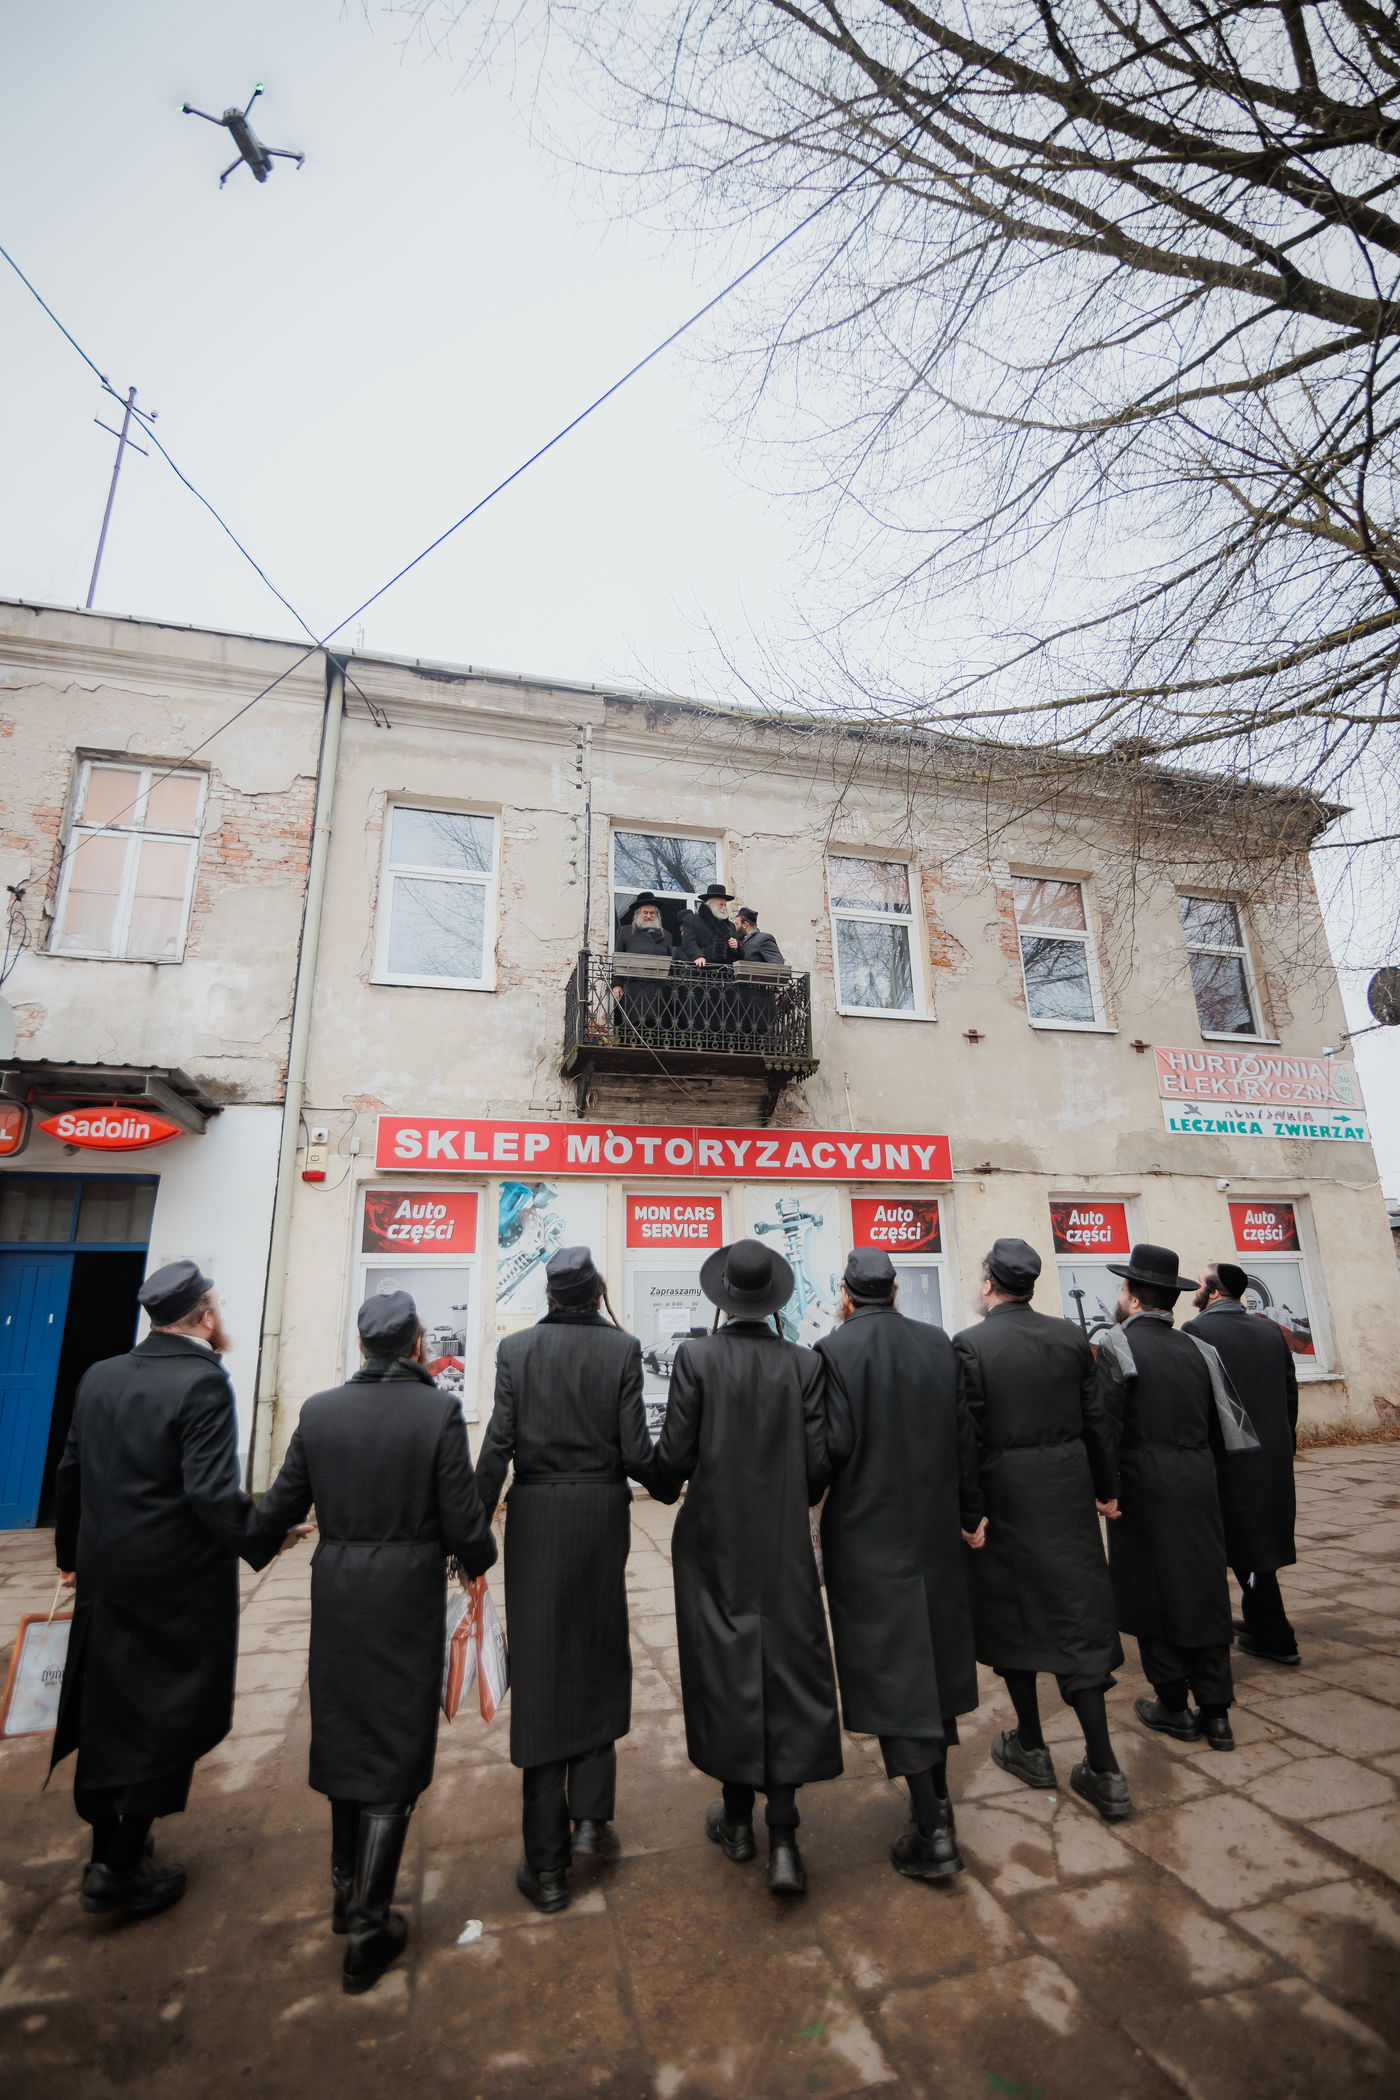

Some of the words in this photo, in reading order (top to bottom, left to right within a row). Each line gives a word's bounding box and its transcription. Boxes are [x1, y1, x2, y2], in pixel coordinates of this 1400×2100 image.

[1162, 1074, 1339, 1102] ELEKTRYCZNA
[57, 1114, 150, 1139] Sadolin
[1169, 1117, 1263, 1135] LECZNICA
[394, 1128, 550, 1161] SKLEP
[567, 1134, 936, 1171] MOTORYZACYJNY
[394, 1199, 447, 1219] Auto
[634, 1205, 671, 1220] MON
[673, 1206, 716, 1221] CARS
[873, 1205, 914, 1222] Auto
[1068, 1209, 1104, 1225] Auto
[1244, 1209, 1276, 1225] Auto
[387, 1219, 455, 1244] części
[641, 1223, 709, 1238] SERVICE
[869, 1221, 922, 1244] części
[1066, 1225, 1112, 1246] części
[1242, 1224, 1283, 1244] części
[650, 1286, 702, 1297] Zapraszamy
